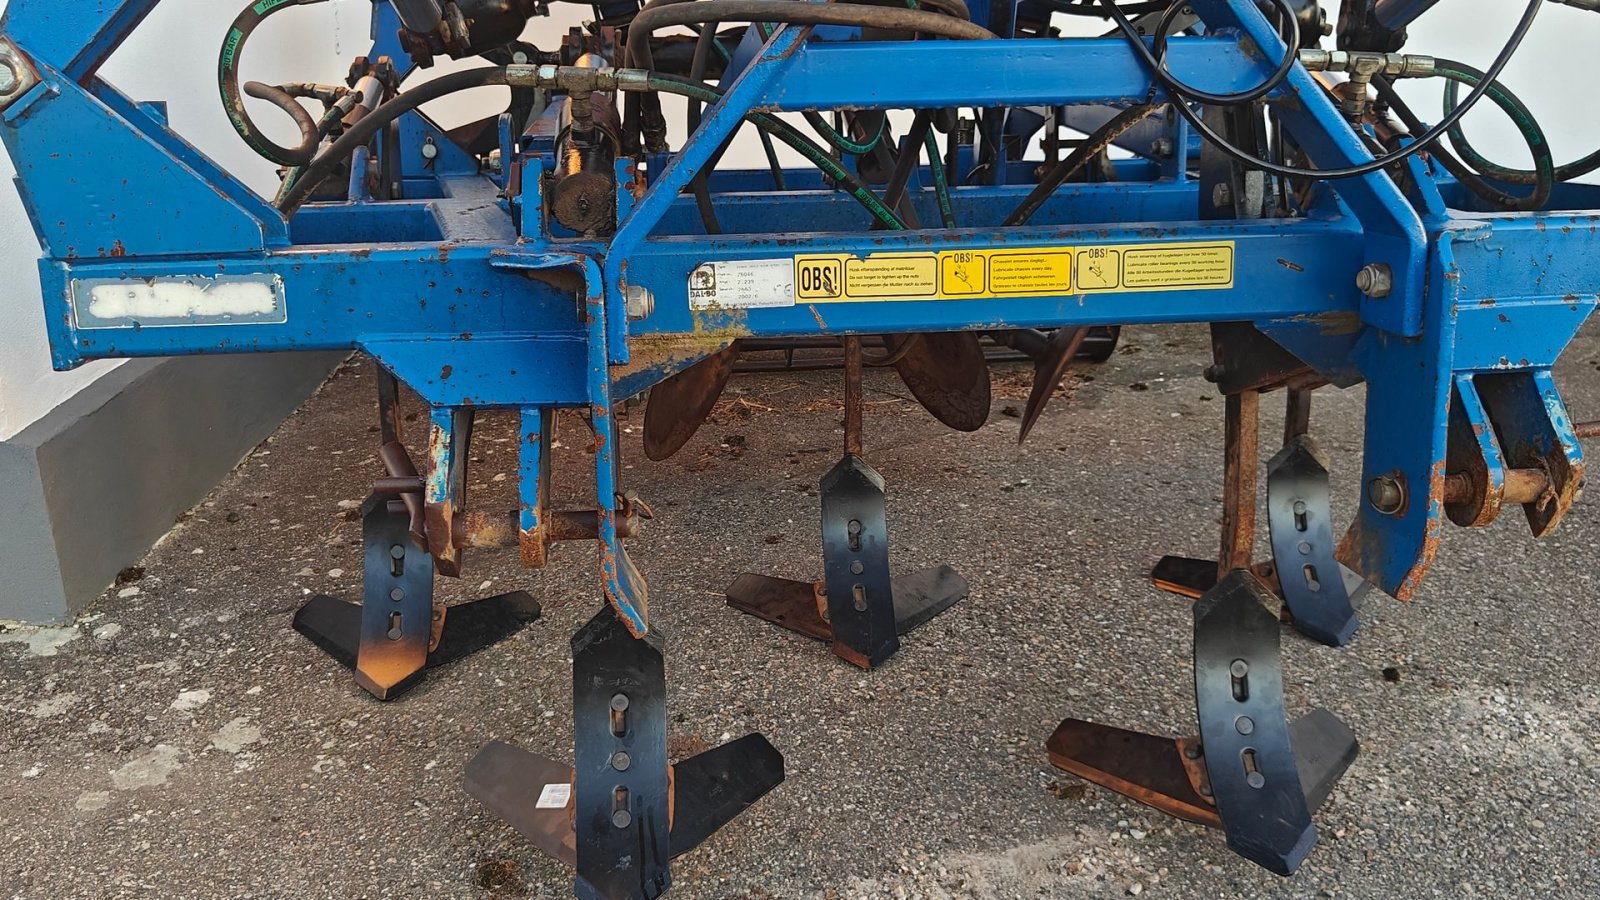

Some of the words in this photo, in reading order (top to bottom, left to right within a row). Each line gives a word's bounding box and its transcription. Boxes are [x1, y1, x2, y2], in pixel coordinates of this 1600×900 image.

[226, 36, 238, 56] BAR
[954, 253, 974, 263] OBS!
[1088, 248, 1108, 258] OBS!
[802, 266, 837, 291] OBS!
